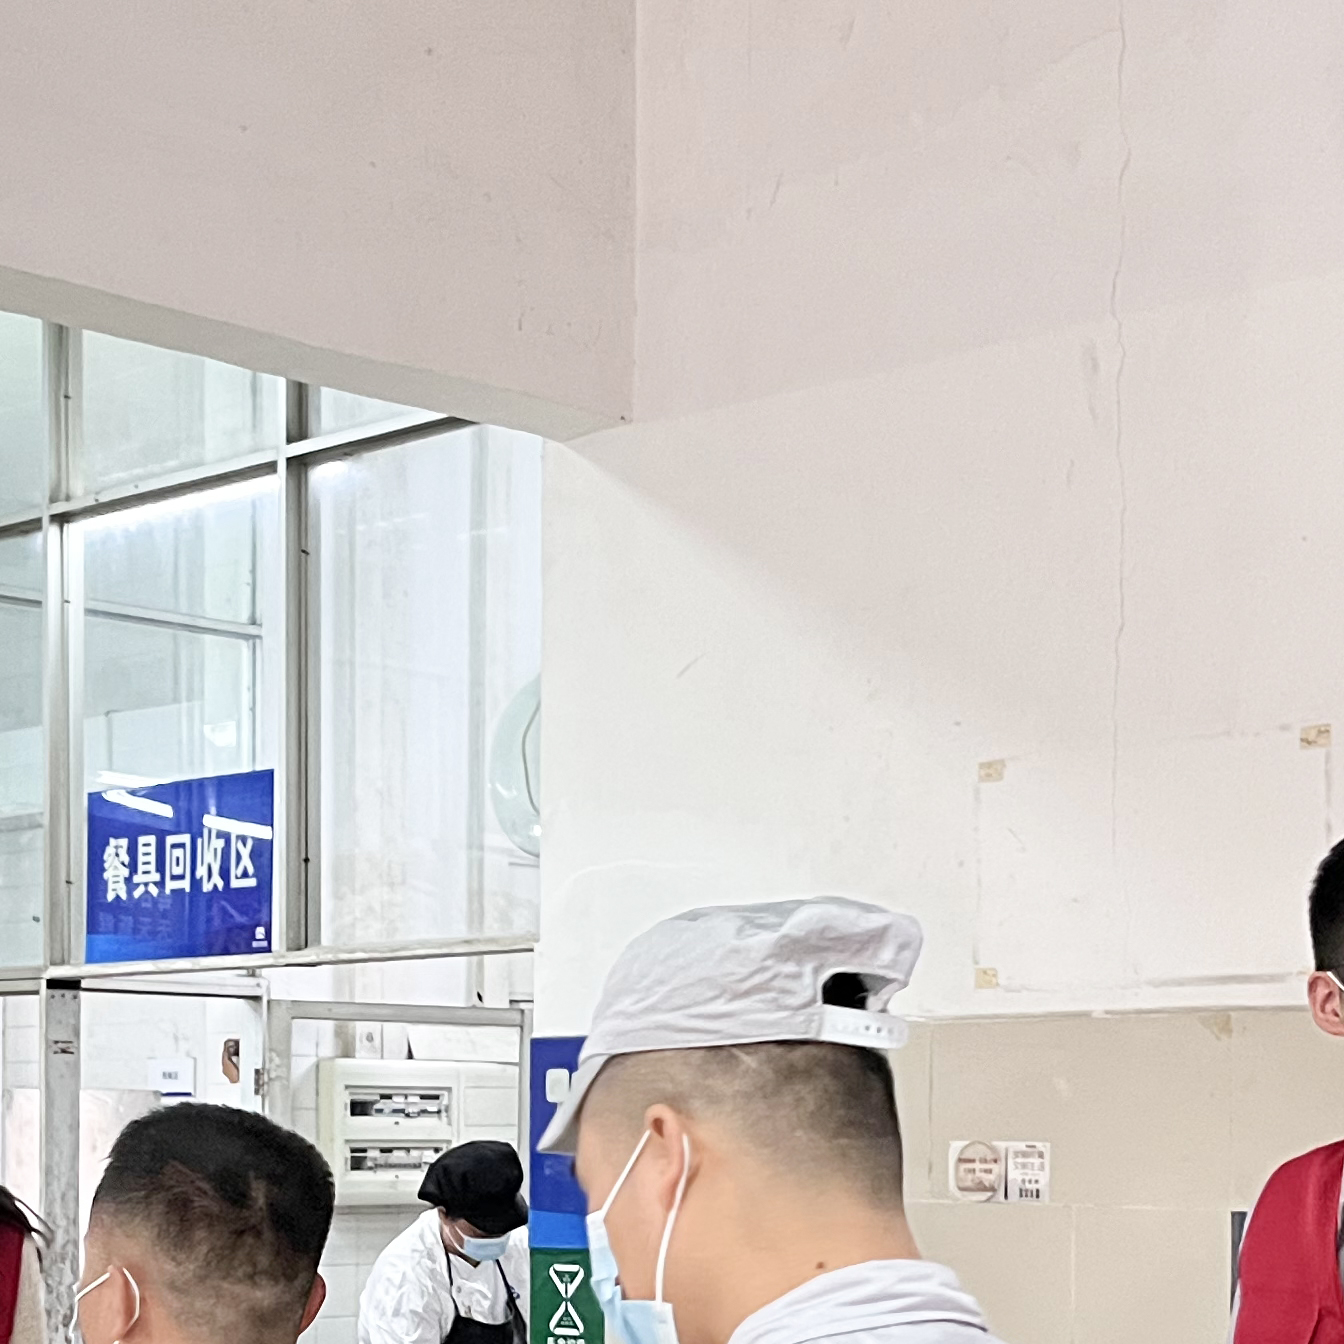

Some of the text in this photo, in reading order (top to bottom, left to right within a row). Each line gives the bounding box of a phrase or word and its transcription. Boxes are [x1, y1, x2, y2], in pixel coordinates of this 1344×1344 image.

[103, 826, 258, 903] 餐具回收区
